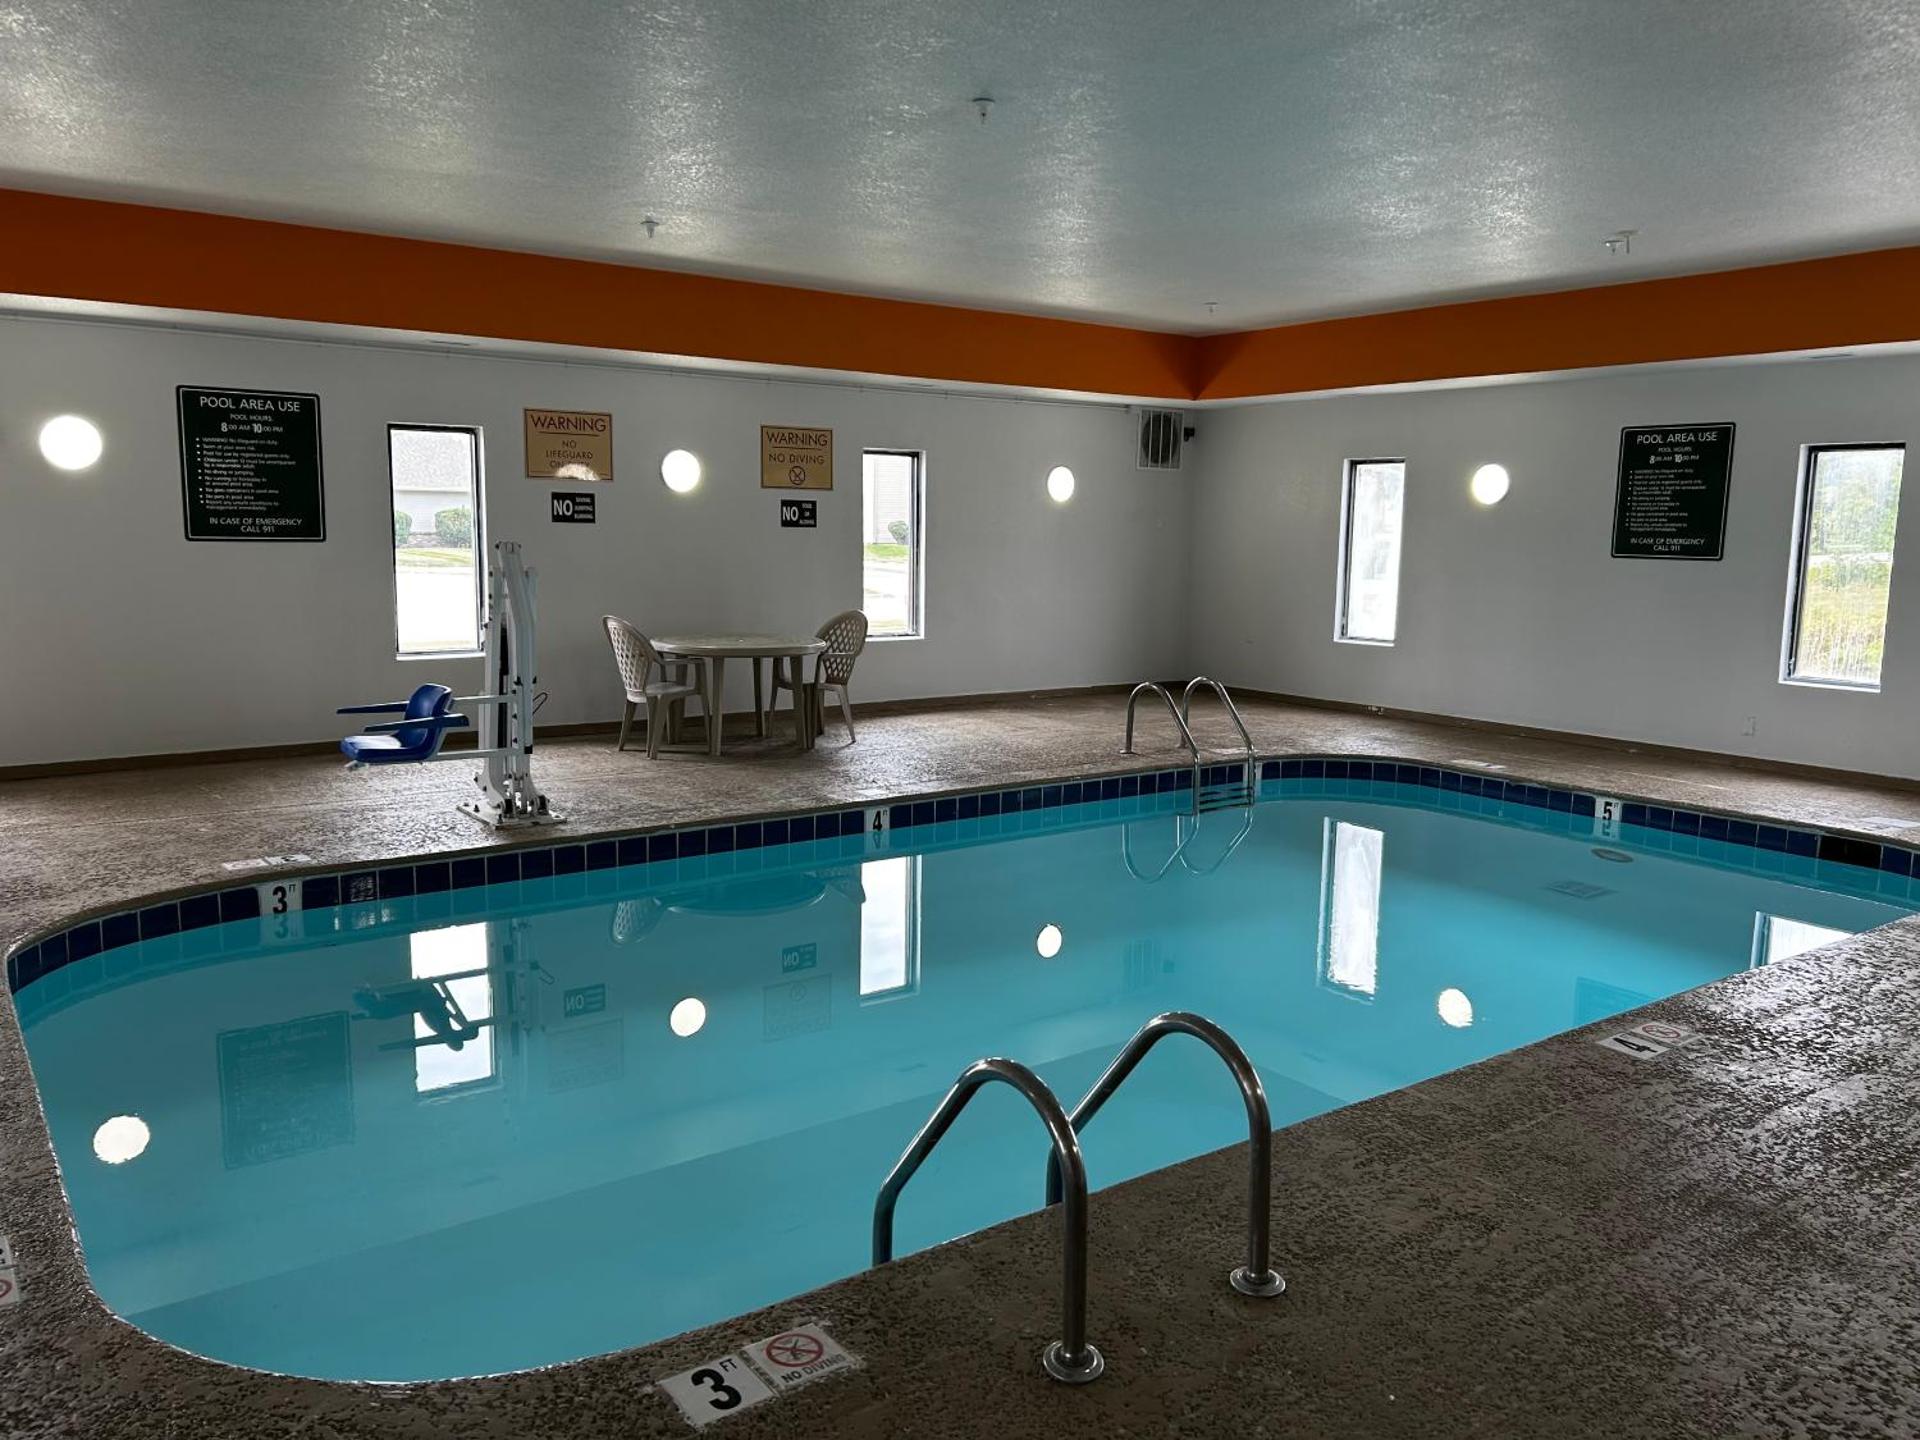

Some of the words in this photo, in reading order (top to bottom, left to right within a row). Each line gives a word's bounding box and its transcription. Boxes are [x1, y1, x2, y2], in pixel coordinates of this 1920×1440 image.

[200, 396, 236, 409] POOL
[240, 399, 275, 411] AREA
[279, 401, 301, 412] USE
[530, 415, 607, 432] WARNING
[562, 440, 577, 449] NO
[766, 432, 828, 446] WARNING
[1636, 434, 1664, 444] POOL
[1666, 432, 1696, 443] AREA
[1698, 431, 1718, 441] USE
[546, 450, 593, 460] LIFEGUARD
[768, 453, 785, 463] NO
[789, 454, 825, 465] DIVING
[553, 499, 573, 516] NO
[782, 506, 799, 521] NO
[209, 517, 218, 525] IN
[220, 517, 240, 526] CASE
[242, 518, 254, 526] OF
[255, 518, 302, 526] EMERGENCY
[241, 525, 260, 533] CALL
[1602, 801, 1613, 820] 5
[872, 810, 883, 831] 4
[272, 886, 288, 913] 3
[780, 1371, 802, 1384] NO
[803, 1353, 847, 1375] DIVING
[691, 1368, 742, 1410] 3
[719, 1358, 738, 1373] FT
